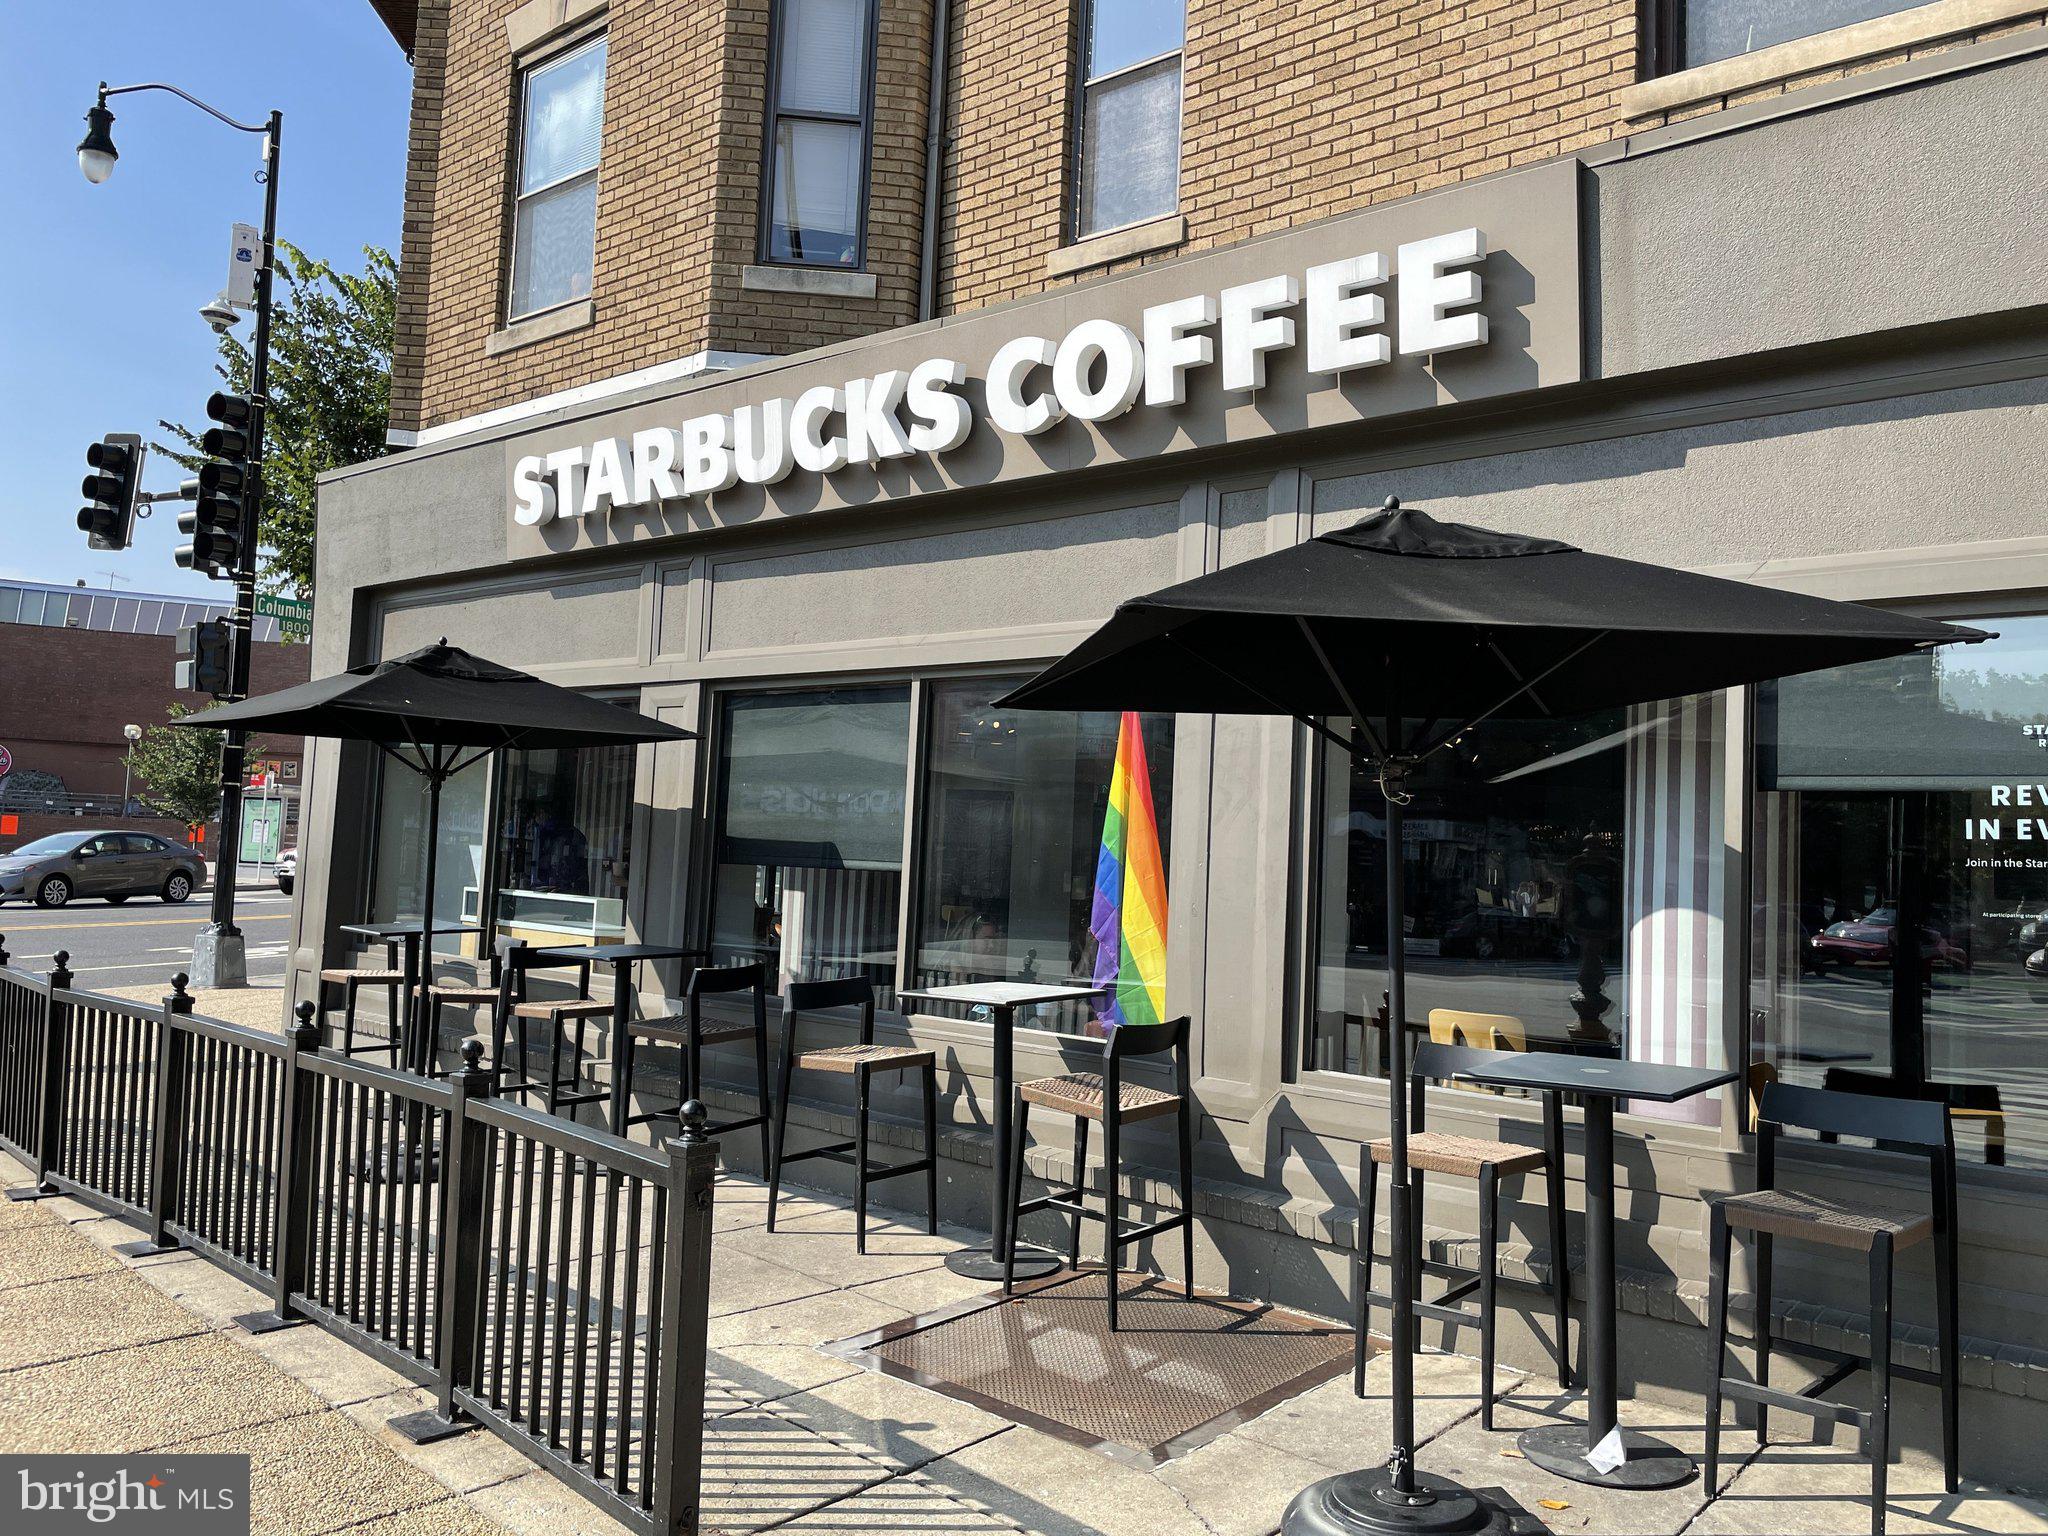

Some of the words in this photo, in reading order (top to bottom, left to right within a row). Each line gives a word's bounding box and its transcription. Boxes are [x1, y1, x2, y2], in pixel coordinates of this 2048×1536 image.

[513, 358, 973, 527] STARBUCKS
[984, 227, 1489, 437] COFFEE
[257, 596, 312, 621] Columbia
[282, 620, 310, 634] 1800
[1965, 818, 2000, 840] IN
[1965, 858, 1988, 868] Join
[1990, 858, 2001, 868] in
[2004, 858, 2023, 868] the
[1989, 911, 2025, 920] participating
